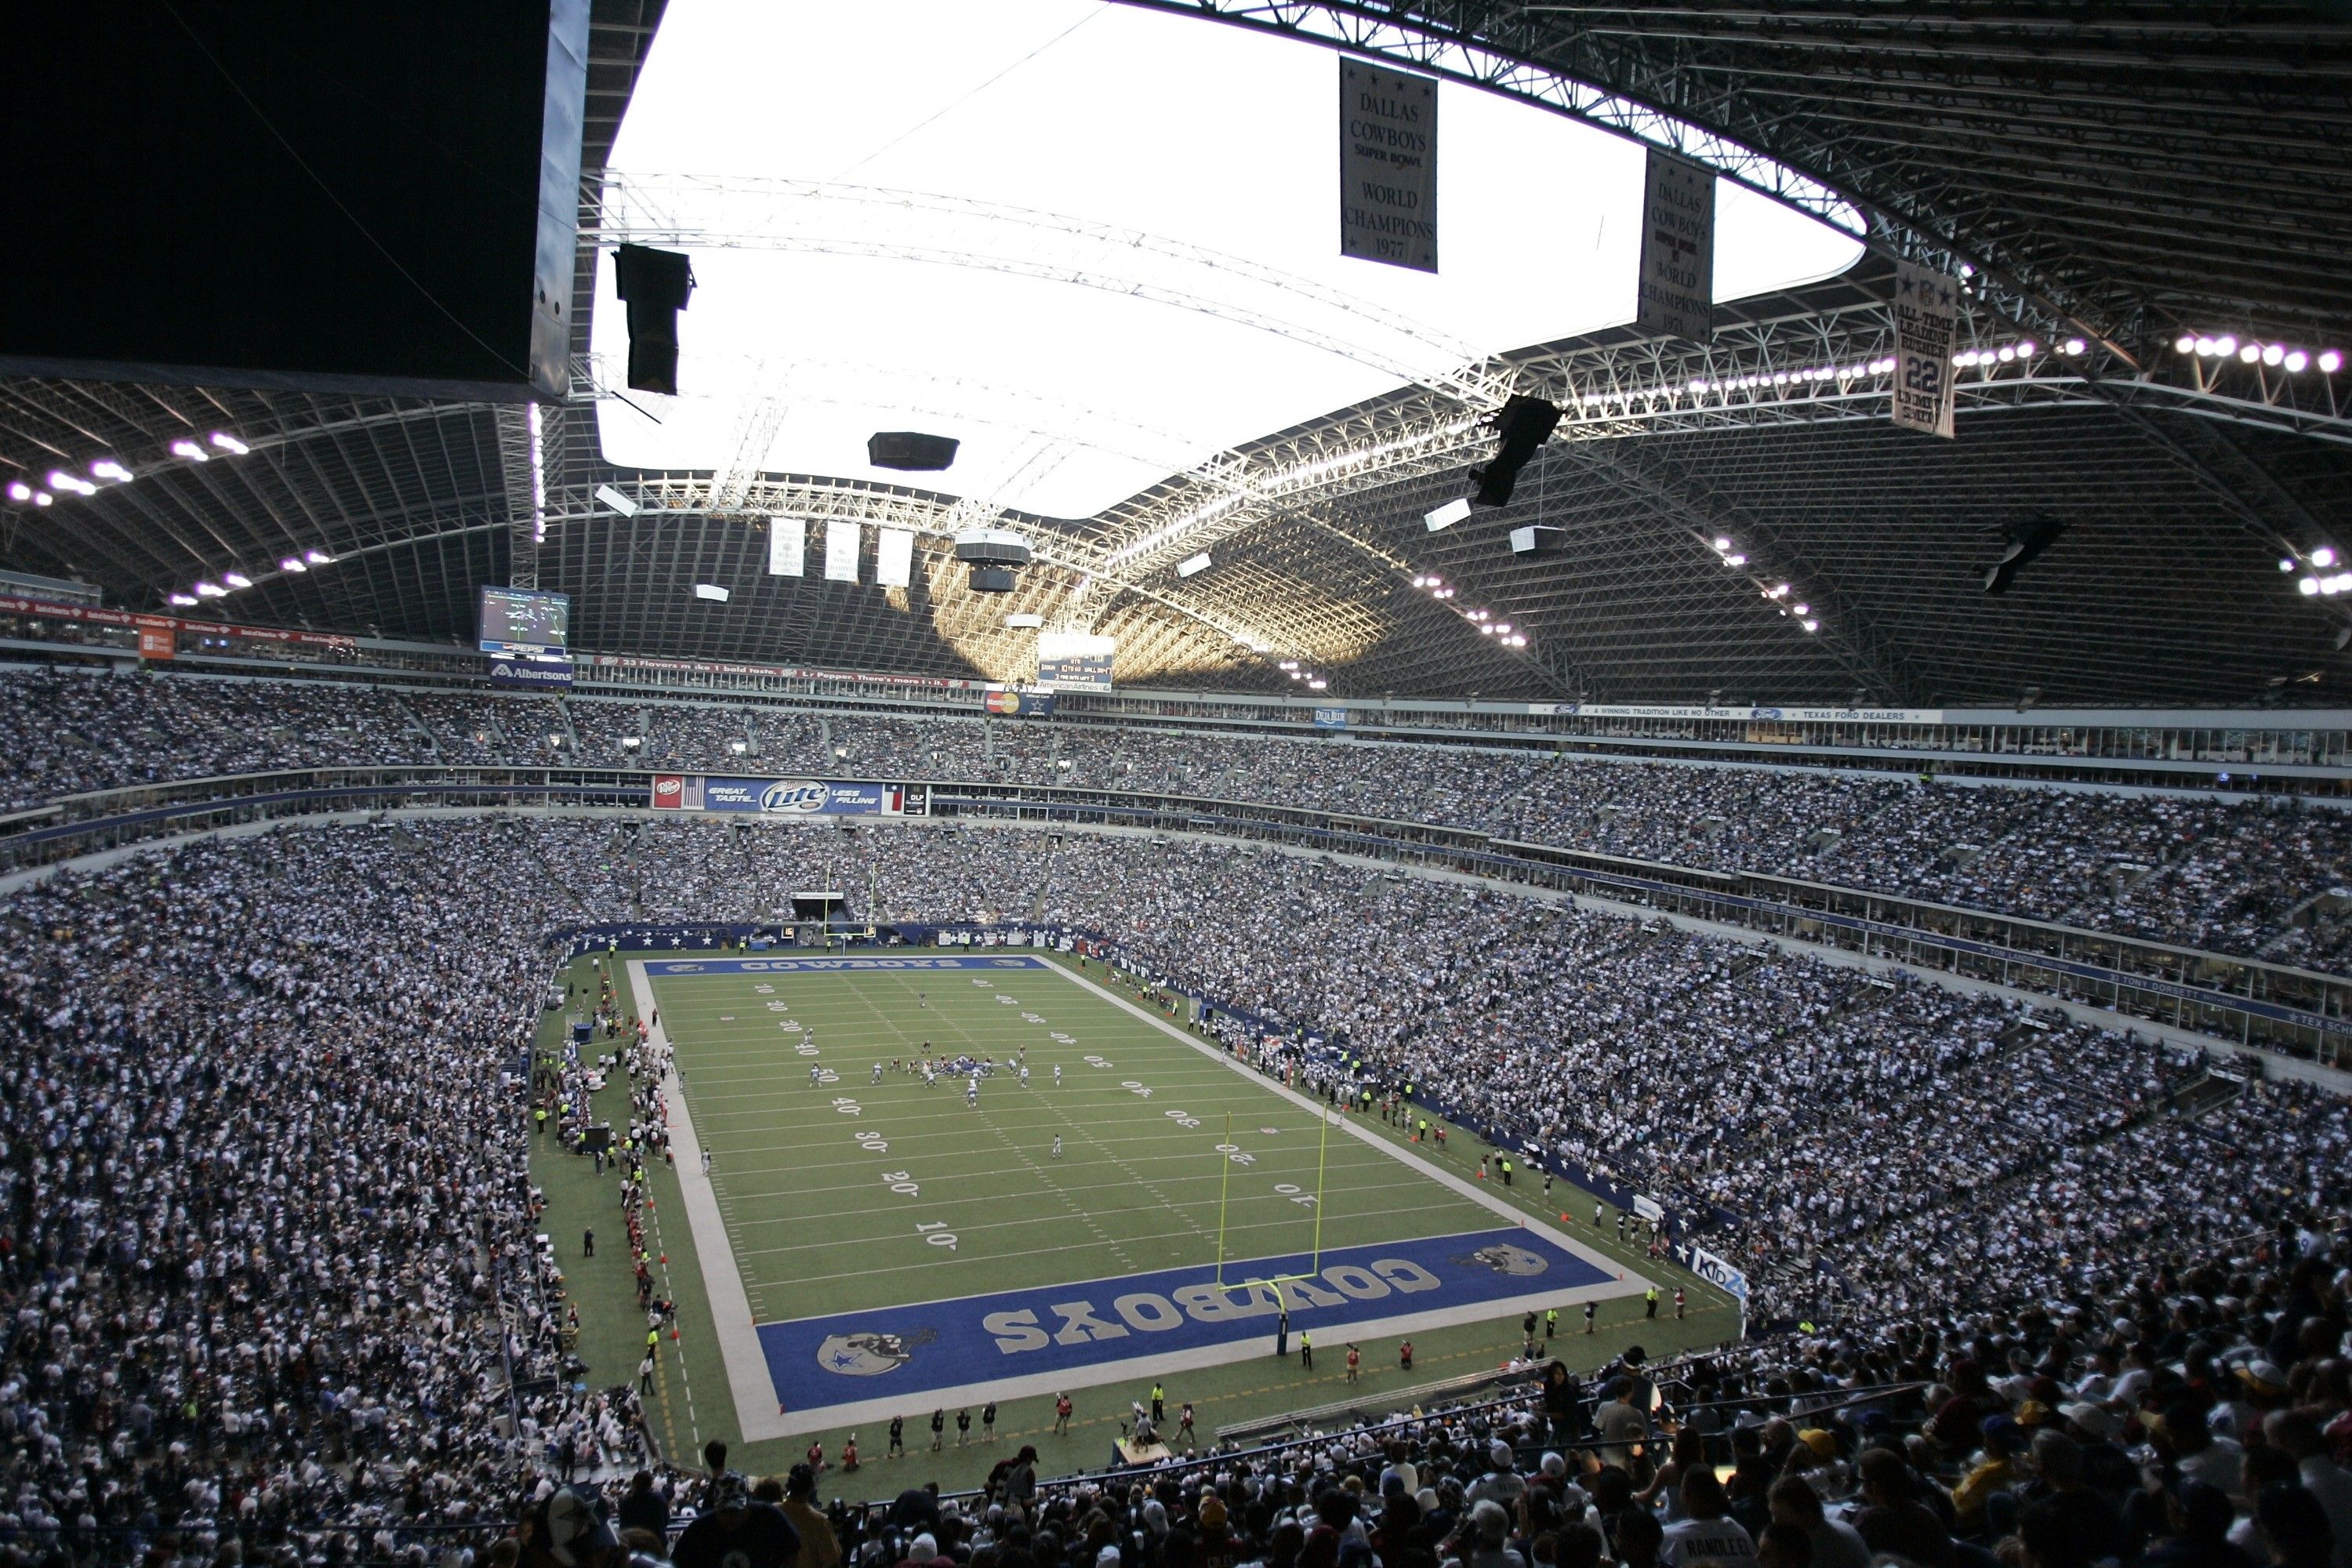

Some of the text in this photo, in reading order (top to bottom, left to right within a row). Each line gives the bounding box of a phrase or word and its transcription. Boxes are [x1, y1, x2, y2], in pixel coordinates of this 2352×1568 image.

[1360, 93, 1418, 123] DALLAS
[1351, 119, 1426, 152] COWBOYS
[1355, 143, 1422, 169] SUPER BOWL
[1362, 181, 1417, 209] WORLD
[1658, 182, 1701, 214] DALLAS
[1345, 207, 1433, 241] CHAMPIONS
[1652, 206, 1706, 241] COWBOYS
[1376, 238, 1404, 259] 1977
[1657, 261, 1697, 289] WORLD
[1642, 282, 1708, 318] CHAMPIONS
[1907, 356, 1939, 394] 22
[513, 644, 545, 653] PEPSI
[514, 668, 572, 681] Albertsons
[767, 787, 826, 808] Lite
[1896, 929, 1920, 940] JORDAN
[740, 960, 962, 971] COWBOYS
[1990, 948, 2038, 964] TOM LANDRY
[754, 983, 775, 993] 10
[2110, 973, 2119, 982] 33
[2123, 976, 2147, 988] TONY
[2152, 982, 2198, 999] DORSETT
[2301, 1014, 2323, 1029] TEX
[1121, 1081, 1153, 1098] 40
[832, 1098, 861, 1113] 40
[1164, 1110, 1200, 1129] 30
[855, 1131, 888, 1150] 30
[1215, 1144, 1256, 1163] 20
[881, 1171, 920, 1193] 20
[1273, 1184, 1320, 1205] 10
[916, 1221, 958, 1246] 10
[982, 1258, 1442, 1356] COWBOYS
